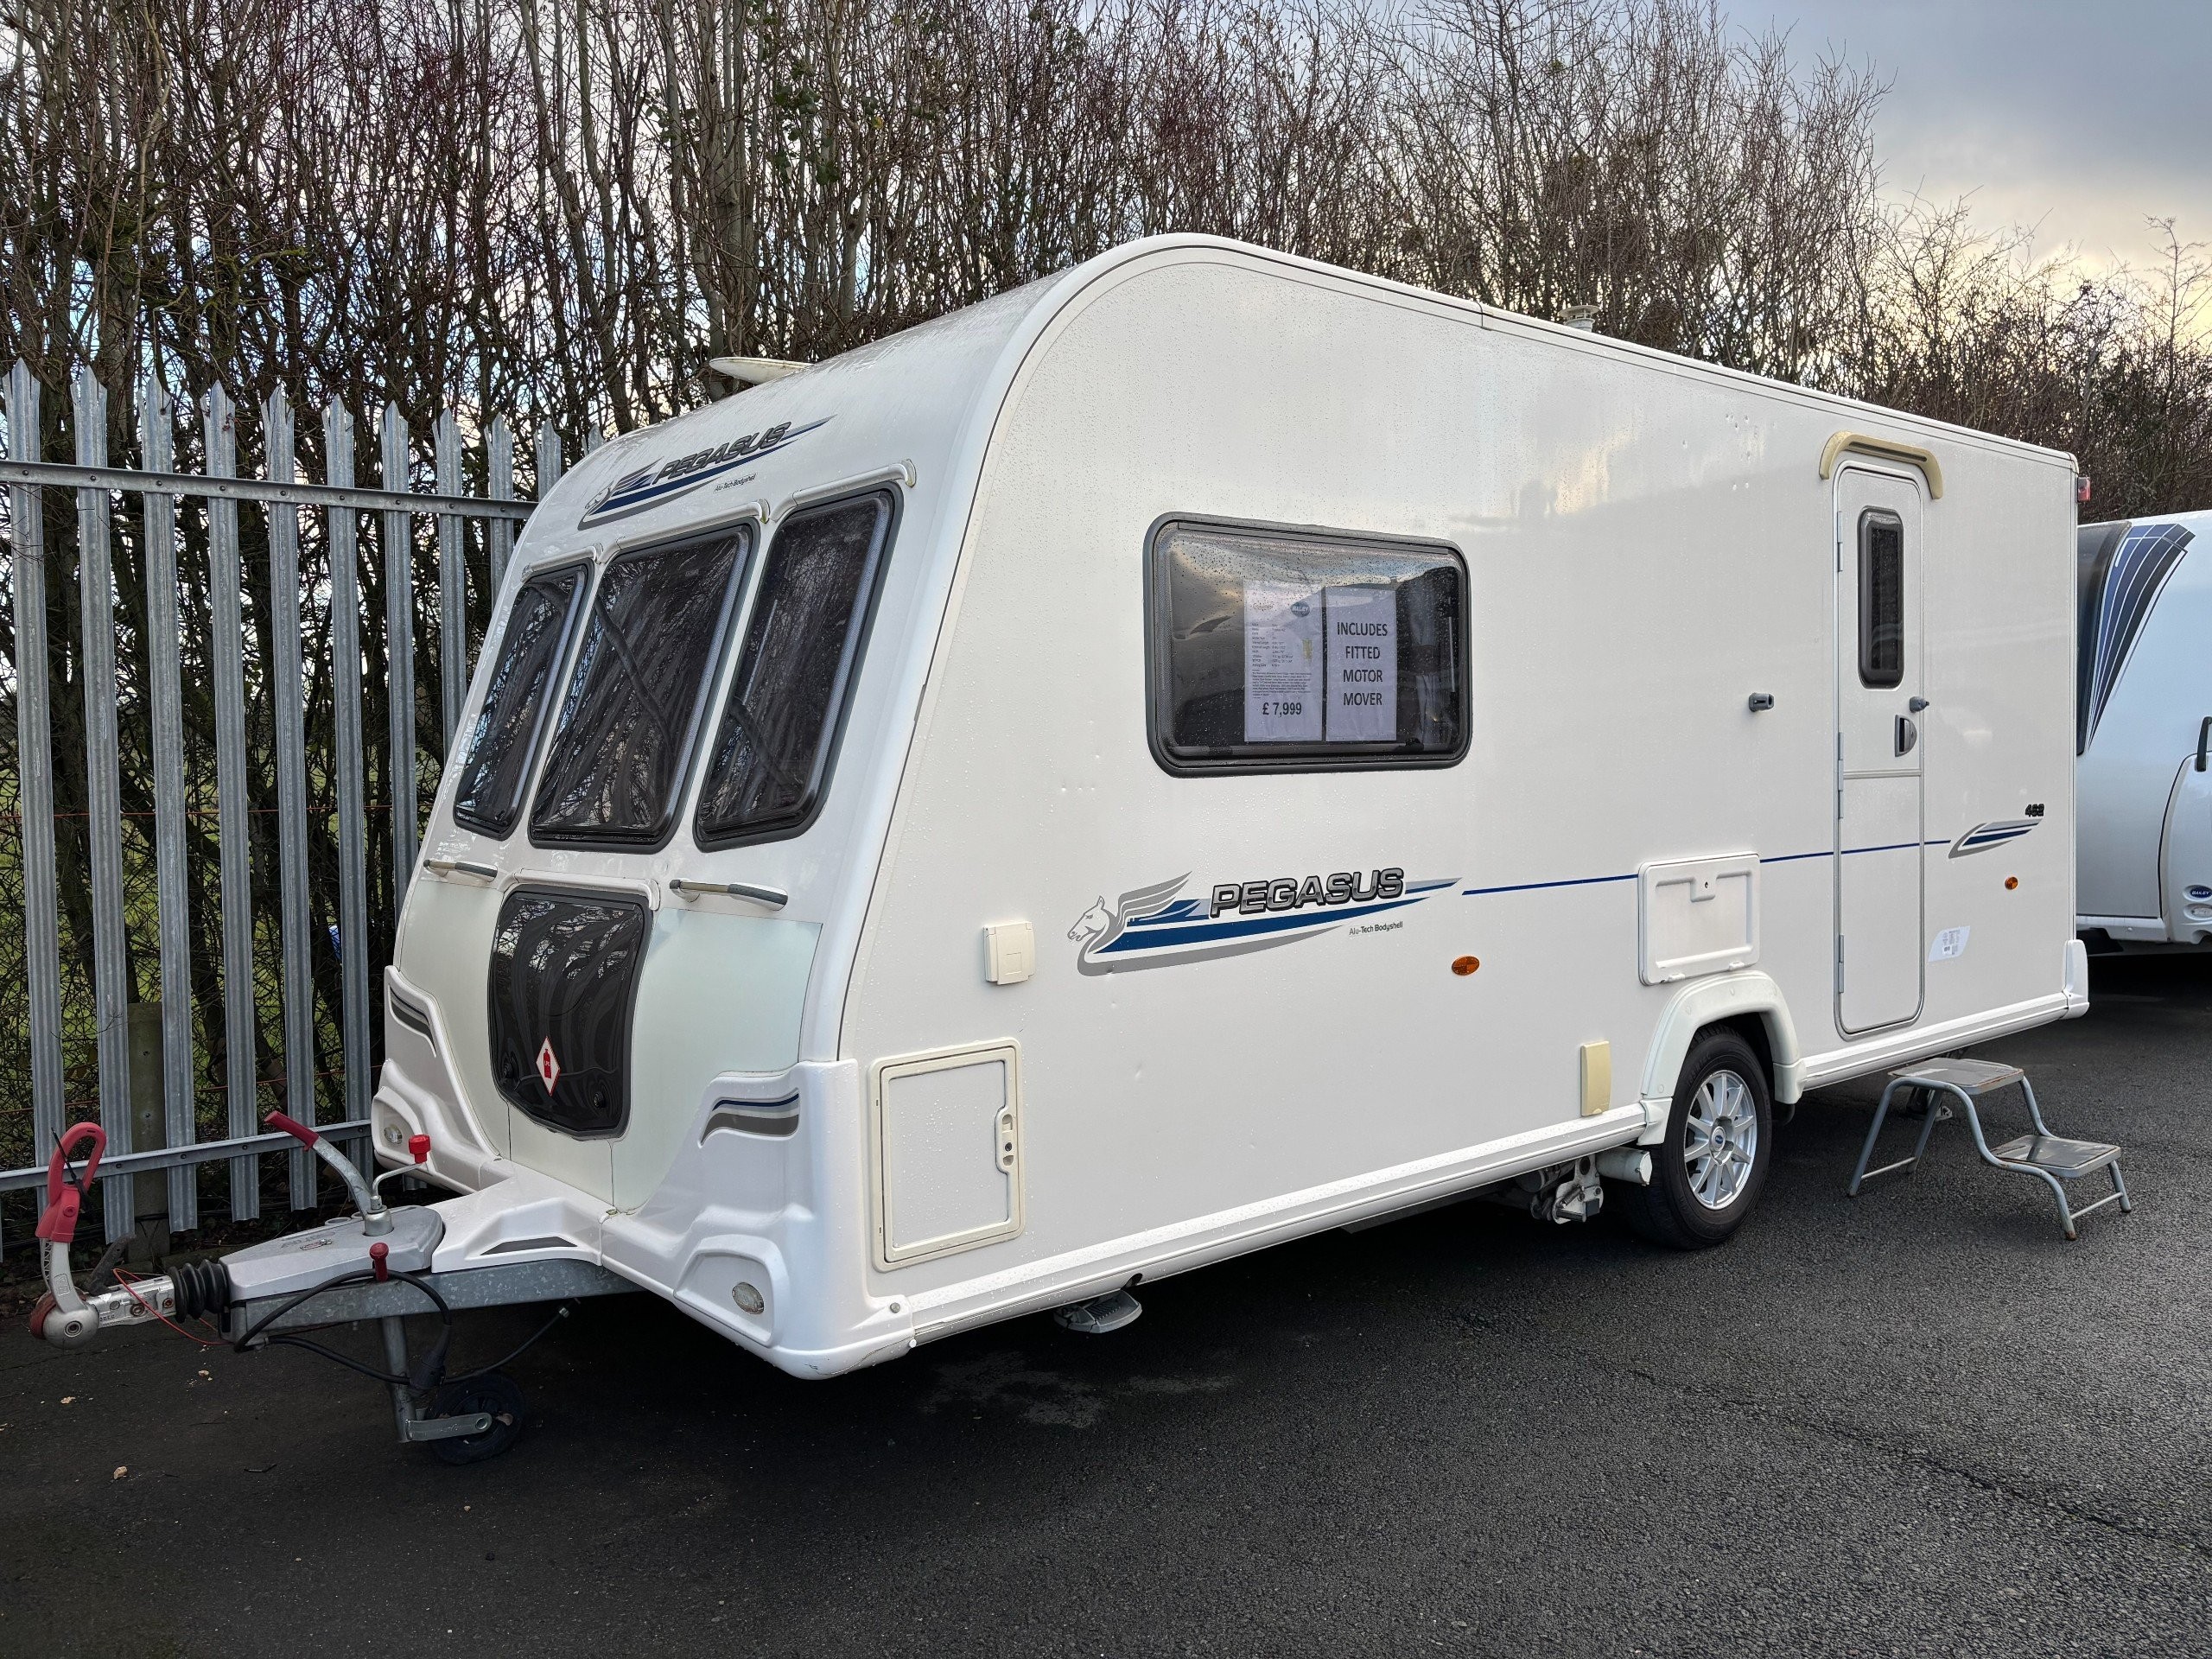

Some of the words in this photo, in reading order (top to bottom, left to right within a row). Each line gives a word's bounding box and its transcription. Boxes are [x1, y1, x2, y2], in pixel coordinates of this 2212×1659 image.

[652, 422, 791, 486] PEGASUS
[1337, 622, 1388, 637] INCLUDES
[1345, 646, 1380, 660] FITTED
[1343, 670, 1382, 683] MOTOR
[1343, 693, 1382, 706] MOVER
[1210, 868, 1404, 918] PEGASUS
[1349, 925, 1374, 936] Alu-Tech
[1375, 921, 1403, 934] Bodyshell
